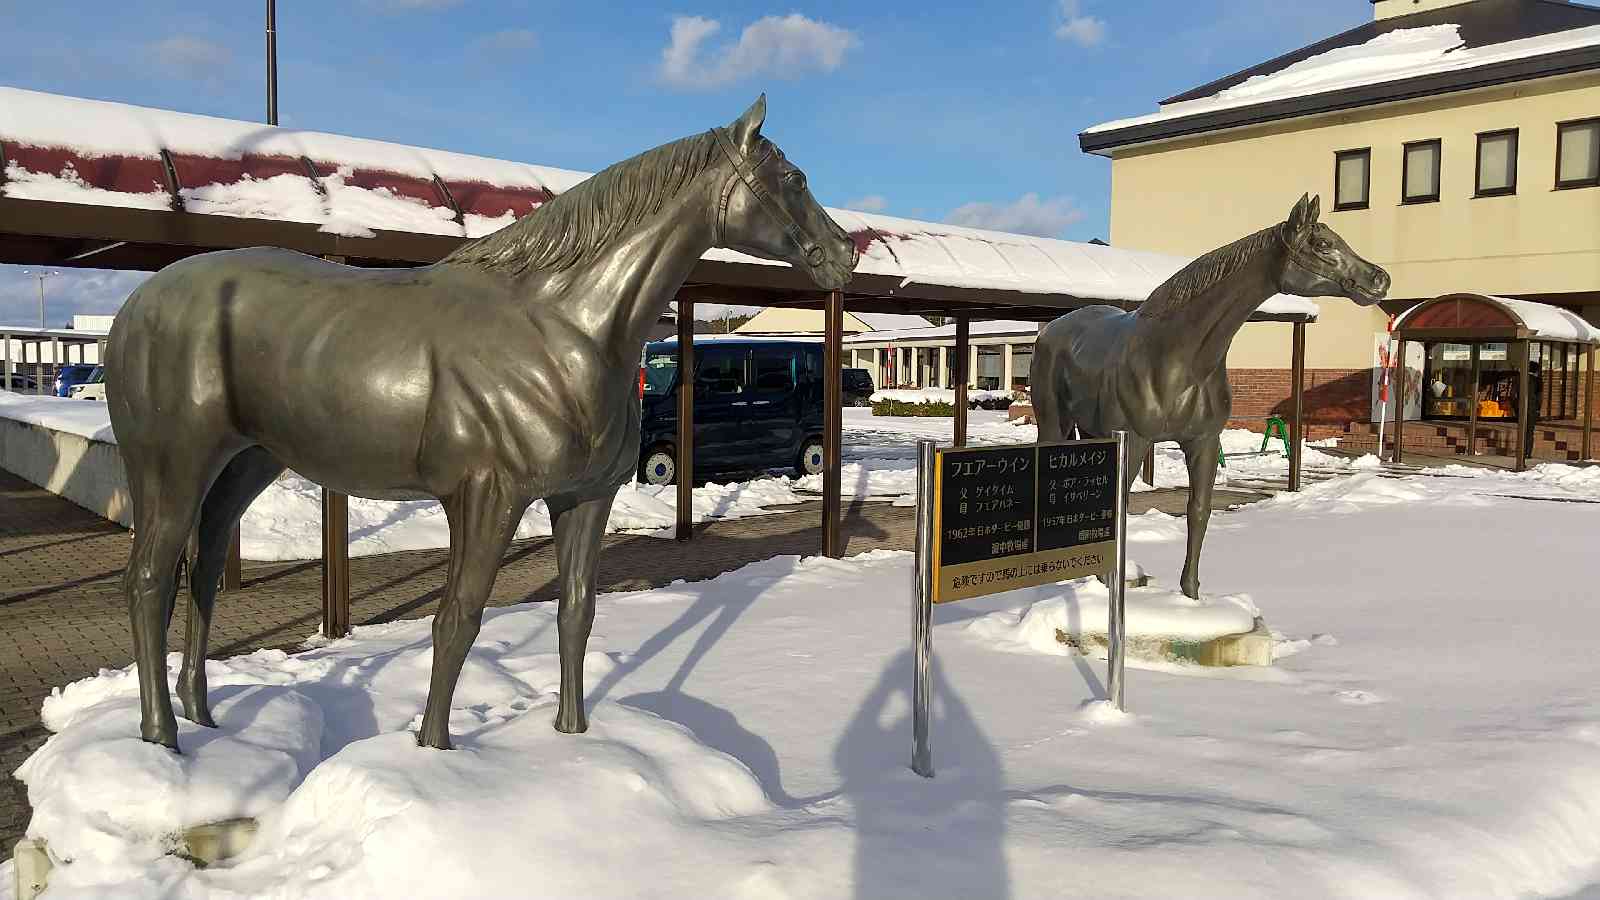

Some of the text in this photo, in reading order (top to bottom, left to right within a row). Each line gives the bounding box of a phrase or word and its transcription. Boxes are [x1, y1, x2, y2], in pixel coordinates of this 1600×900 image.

[1049, 450, 1107, 469] ヒカルメイジ
[1048, 479, 1057, 491] 父
[960, 487, 968, 499] 父
